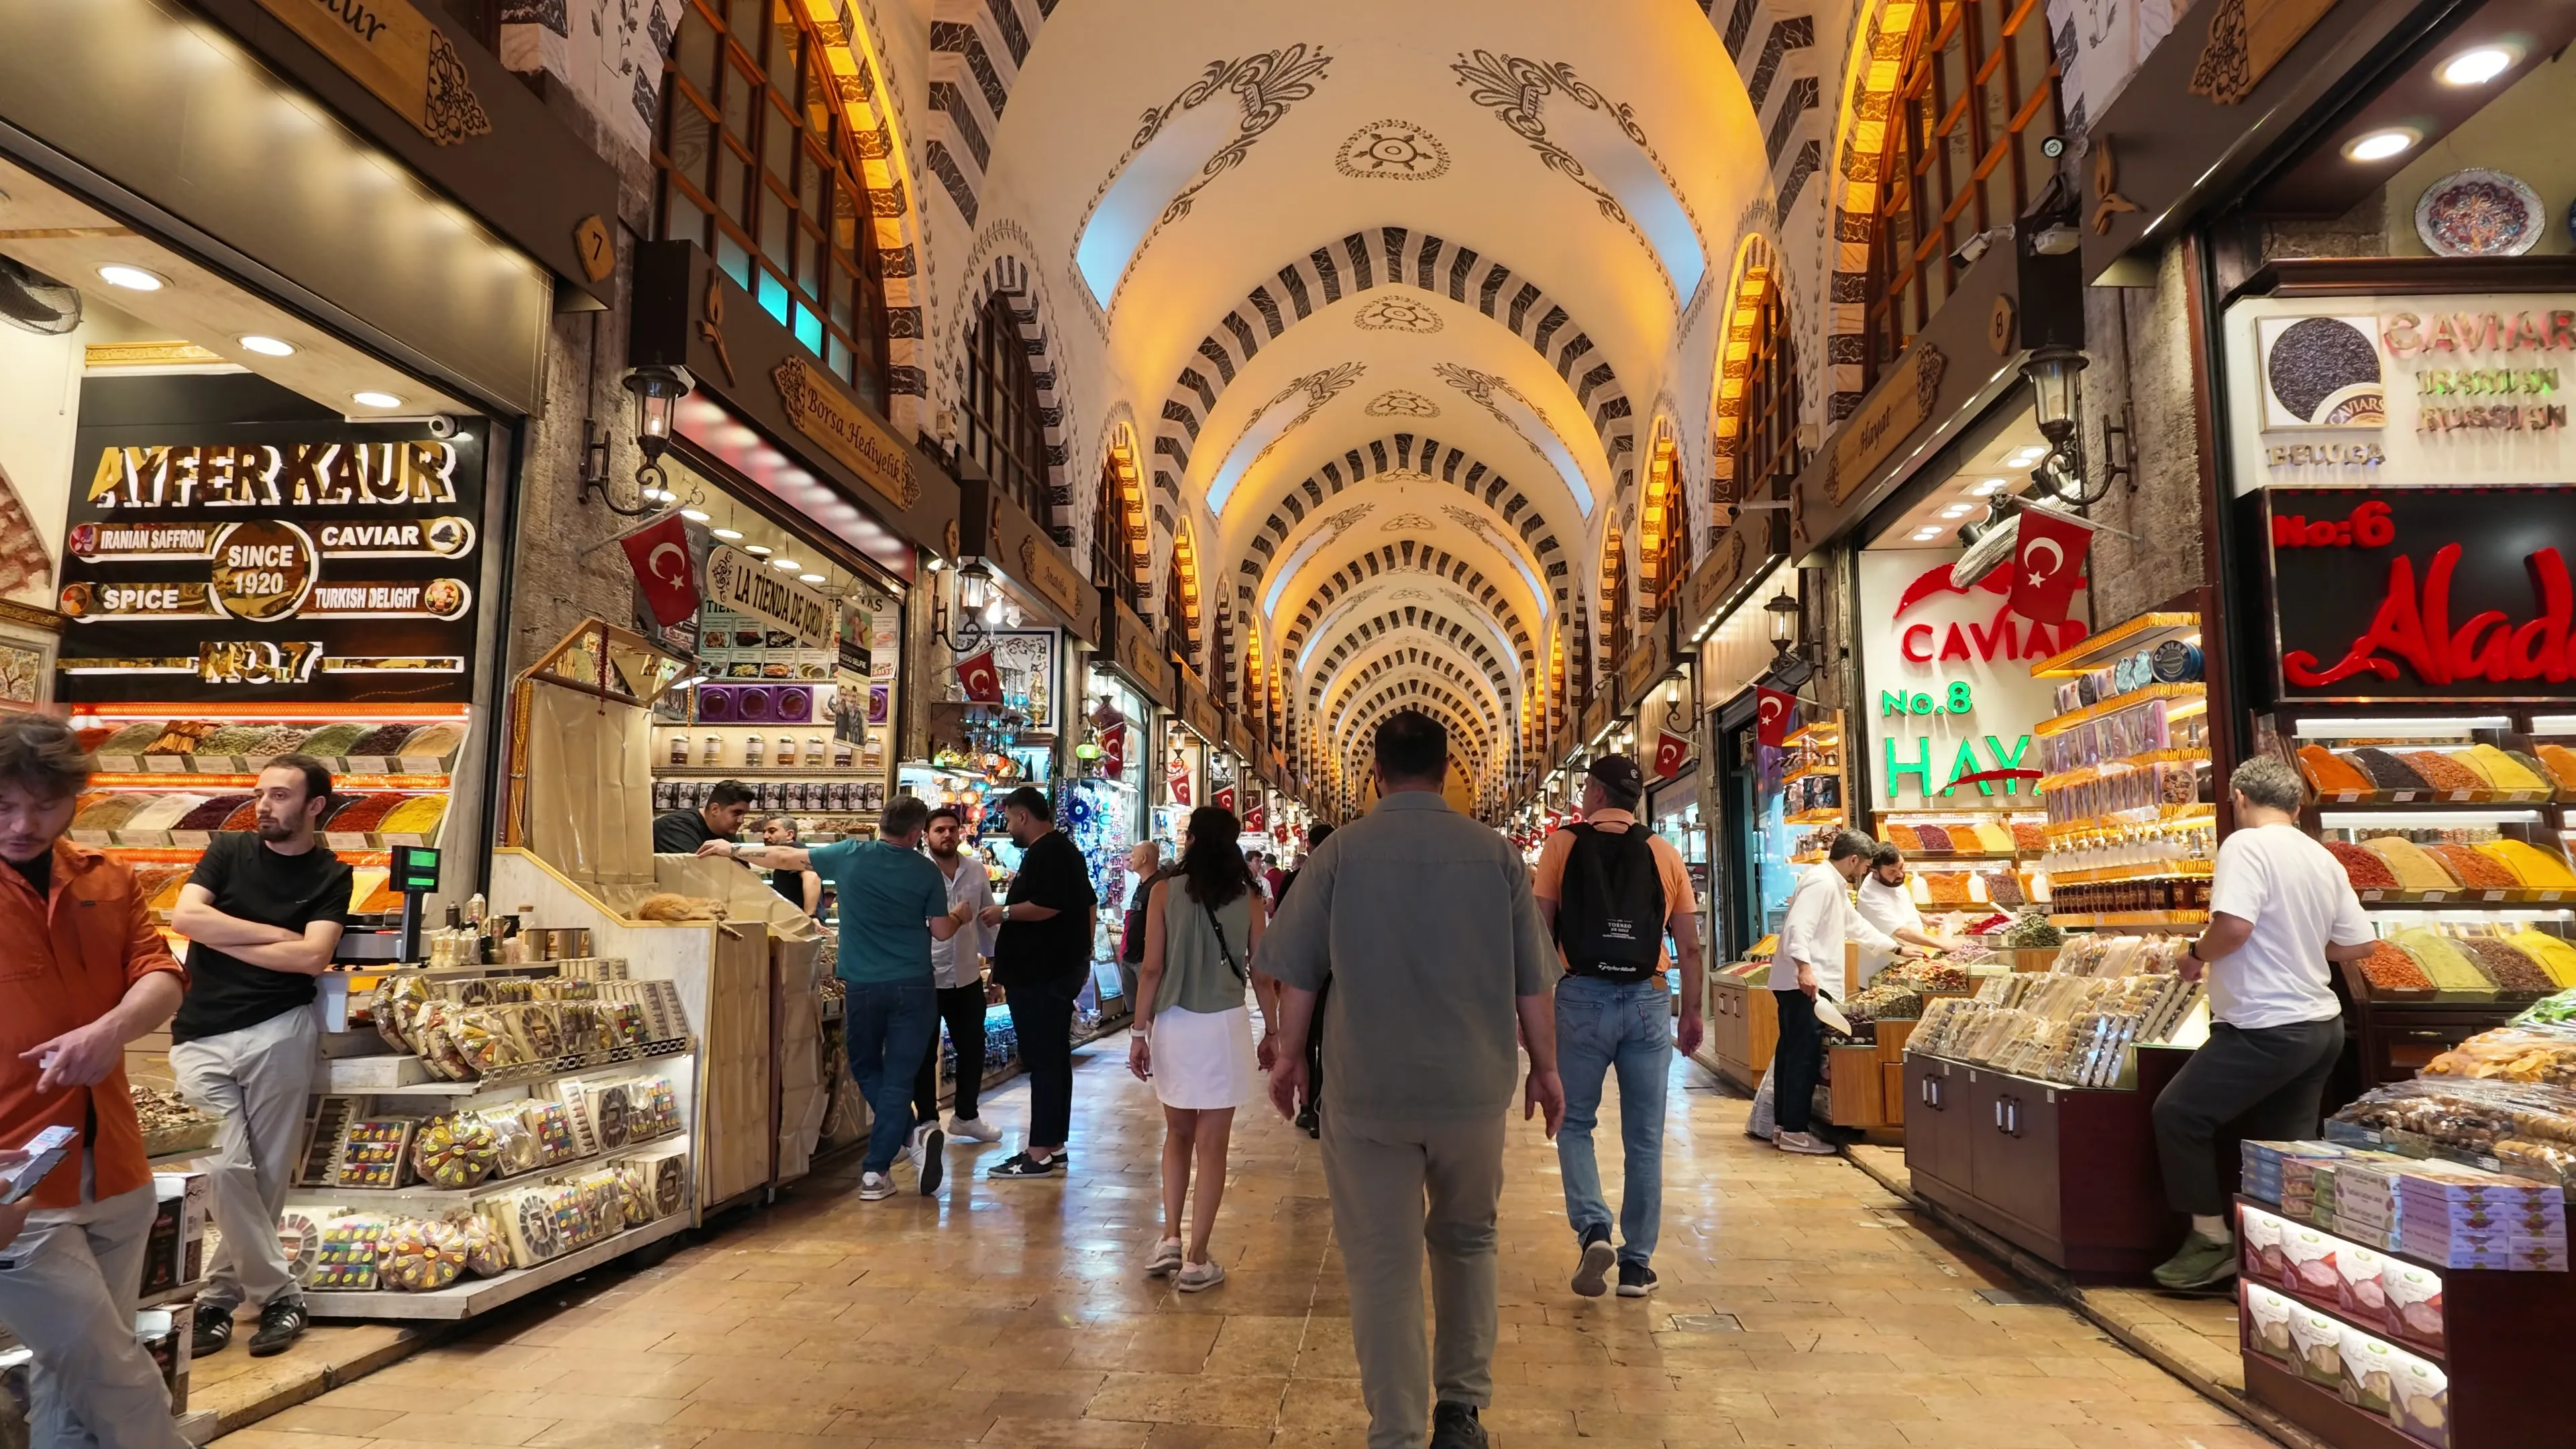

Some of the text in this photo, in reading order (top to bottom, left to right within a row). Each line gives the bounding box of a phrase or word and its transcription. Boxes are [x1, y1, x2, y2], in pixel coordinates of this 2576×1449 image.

[319, 0, 386, 42] ur
[592, 230, 602, 262] 7
[1996, 311, 2003, 338] 8
[2415, 366, 2561, 396] IRANIAN
[1859, 405, 1892, 457] Hayat
[2415, 403, 2568, 432] RUSSIAN
[808, 388, 900, 483] Borsa Hediyelik
[2267, 443, 2387, 468] BELUGA
[87, 441, 457, 508] AYFER KAUR
[100, 529, 205, 549] IRANIAN SAFFRON
[321, 525, 419, 546] CAVIAR
[227, 545, 294, 568] SINCE
[233, 572, 284, 594] 1920
[315, 587, 420, 608] TURKISH DELIGHT
[735, 566, 751, 604] LA
[790, 592, 804, 628] DE
[103, 589, 179, 610] SPICE
[2282, 542, 2576, 688] Alad
[1900, 619, 2088, 663] CAVIAR
[2155, 642, 2189, 662] CAVIAR
[1880, 680, 1972, 718] No.8
[1885, 735, 2043, 798] HAY
